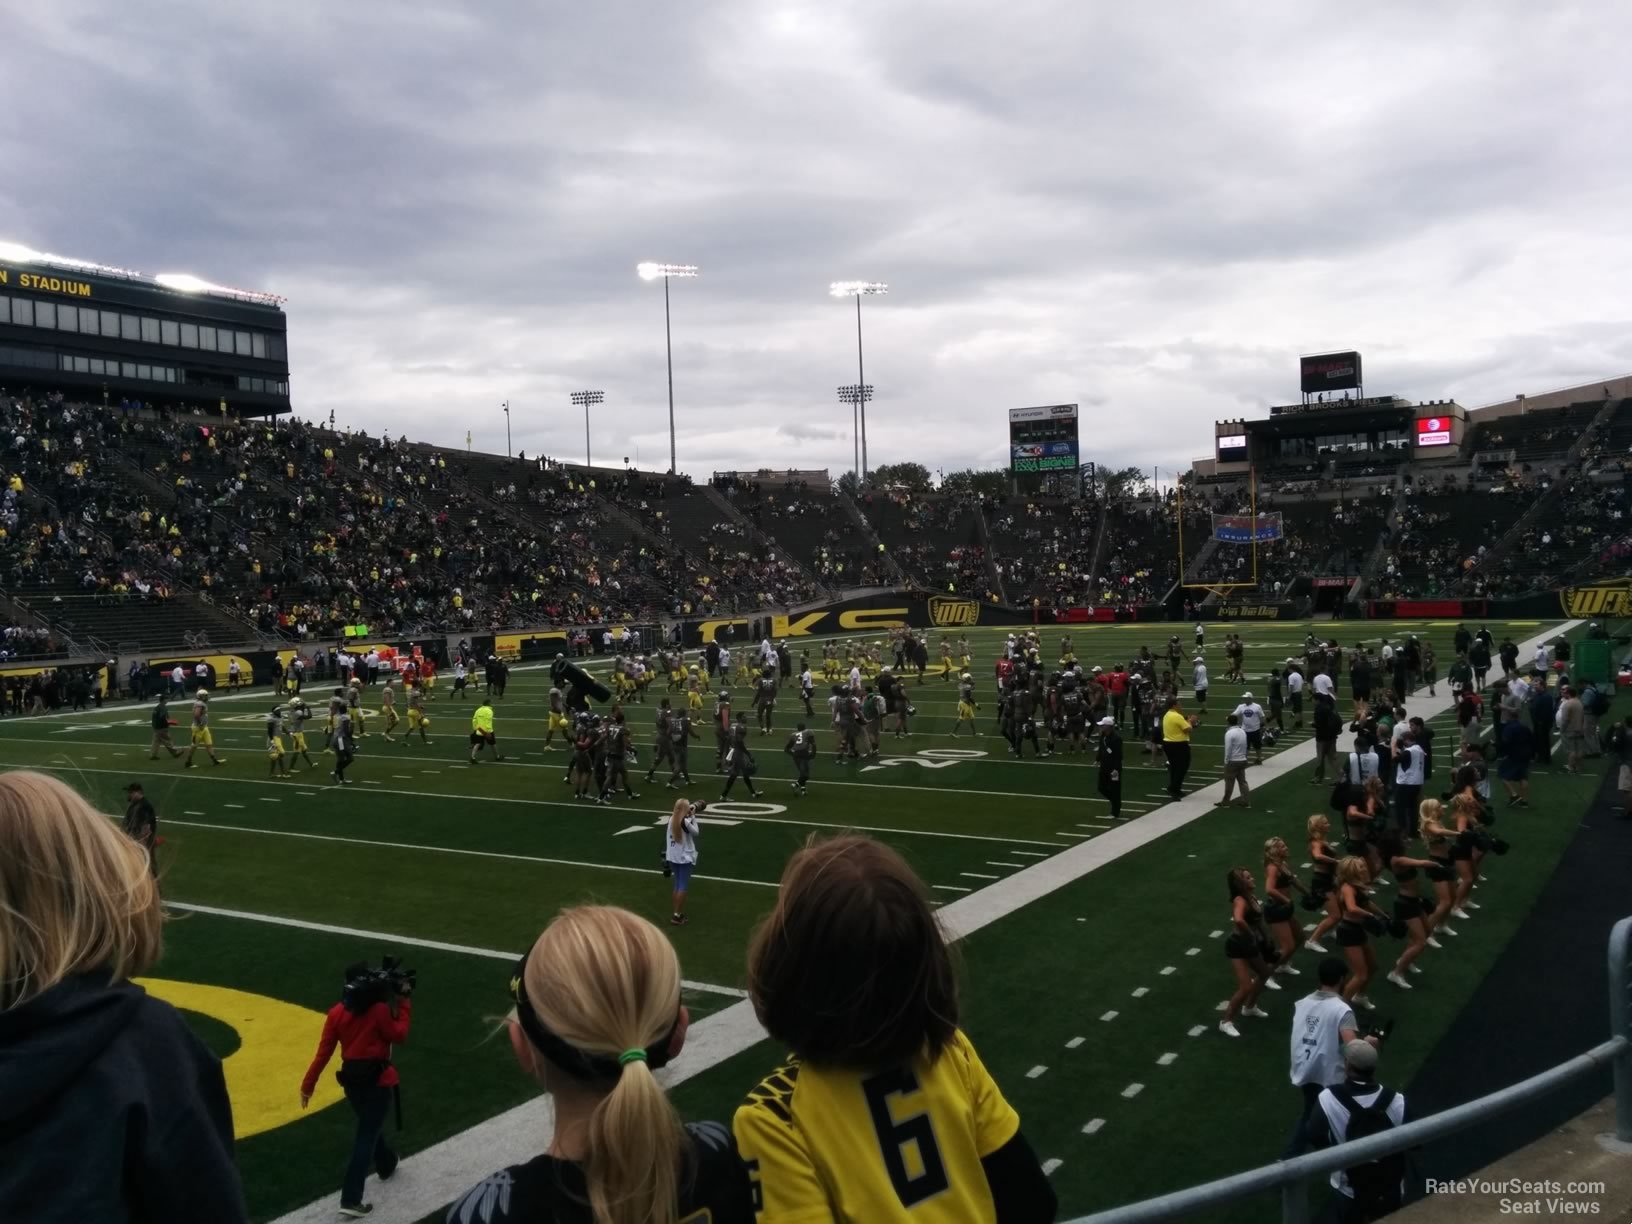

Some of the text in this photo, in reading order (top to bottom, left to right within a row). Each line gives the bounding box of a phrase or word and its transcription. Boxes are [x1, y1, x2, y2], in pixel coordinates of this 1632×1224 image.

[20, 273, 91, 297] STADIUM
[1282, 398, 1380, 413] RICH BROOKS FIELD
[1039, 458, 1076, 468] SIGNS
[1220, 532, 1274, 541] INSURANCE
[795, 731, 803, 744] 3
[1304, 1048, 1311, 1060] 7
[861, 1066, 952, 1210] 6
